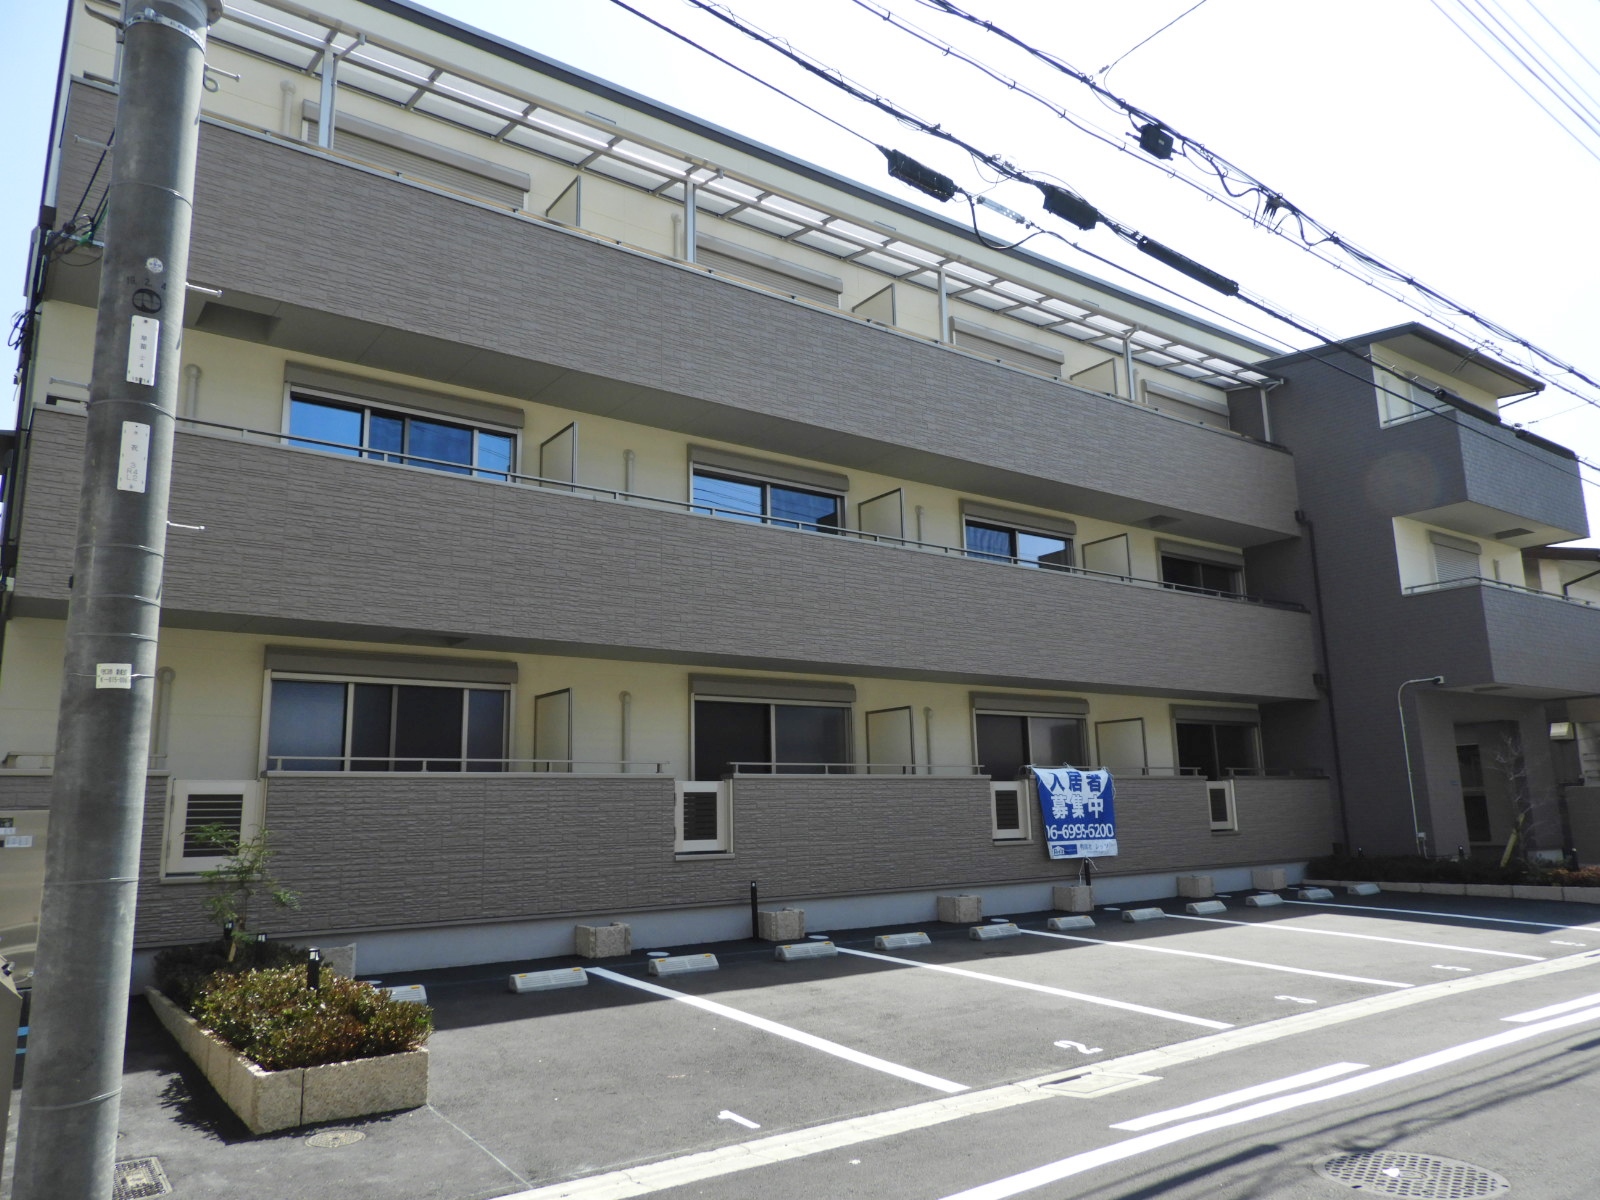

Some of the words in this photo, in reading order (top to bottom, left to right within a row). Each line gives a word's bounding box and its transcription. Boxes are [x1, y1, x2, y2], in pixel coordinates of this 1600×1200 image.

[1049, 771, 1102, 793] 入居者
[1050, 793, 1104, 819] 募集中
[1273, 995, 1318, 1005] 3
[1053, 1040, 1104, 1055] 2
[717, 1109, 761, 1129] 1
